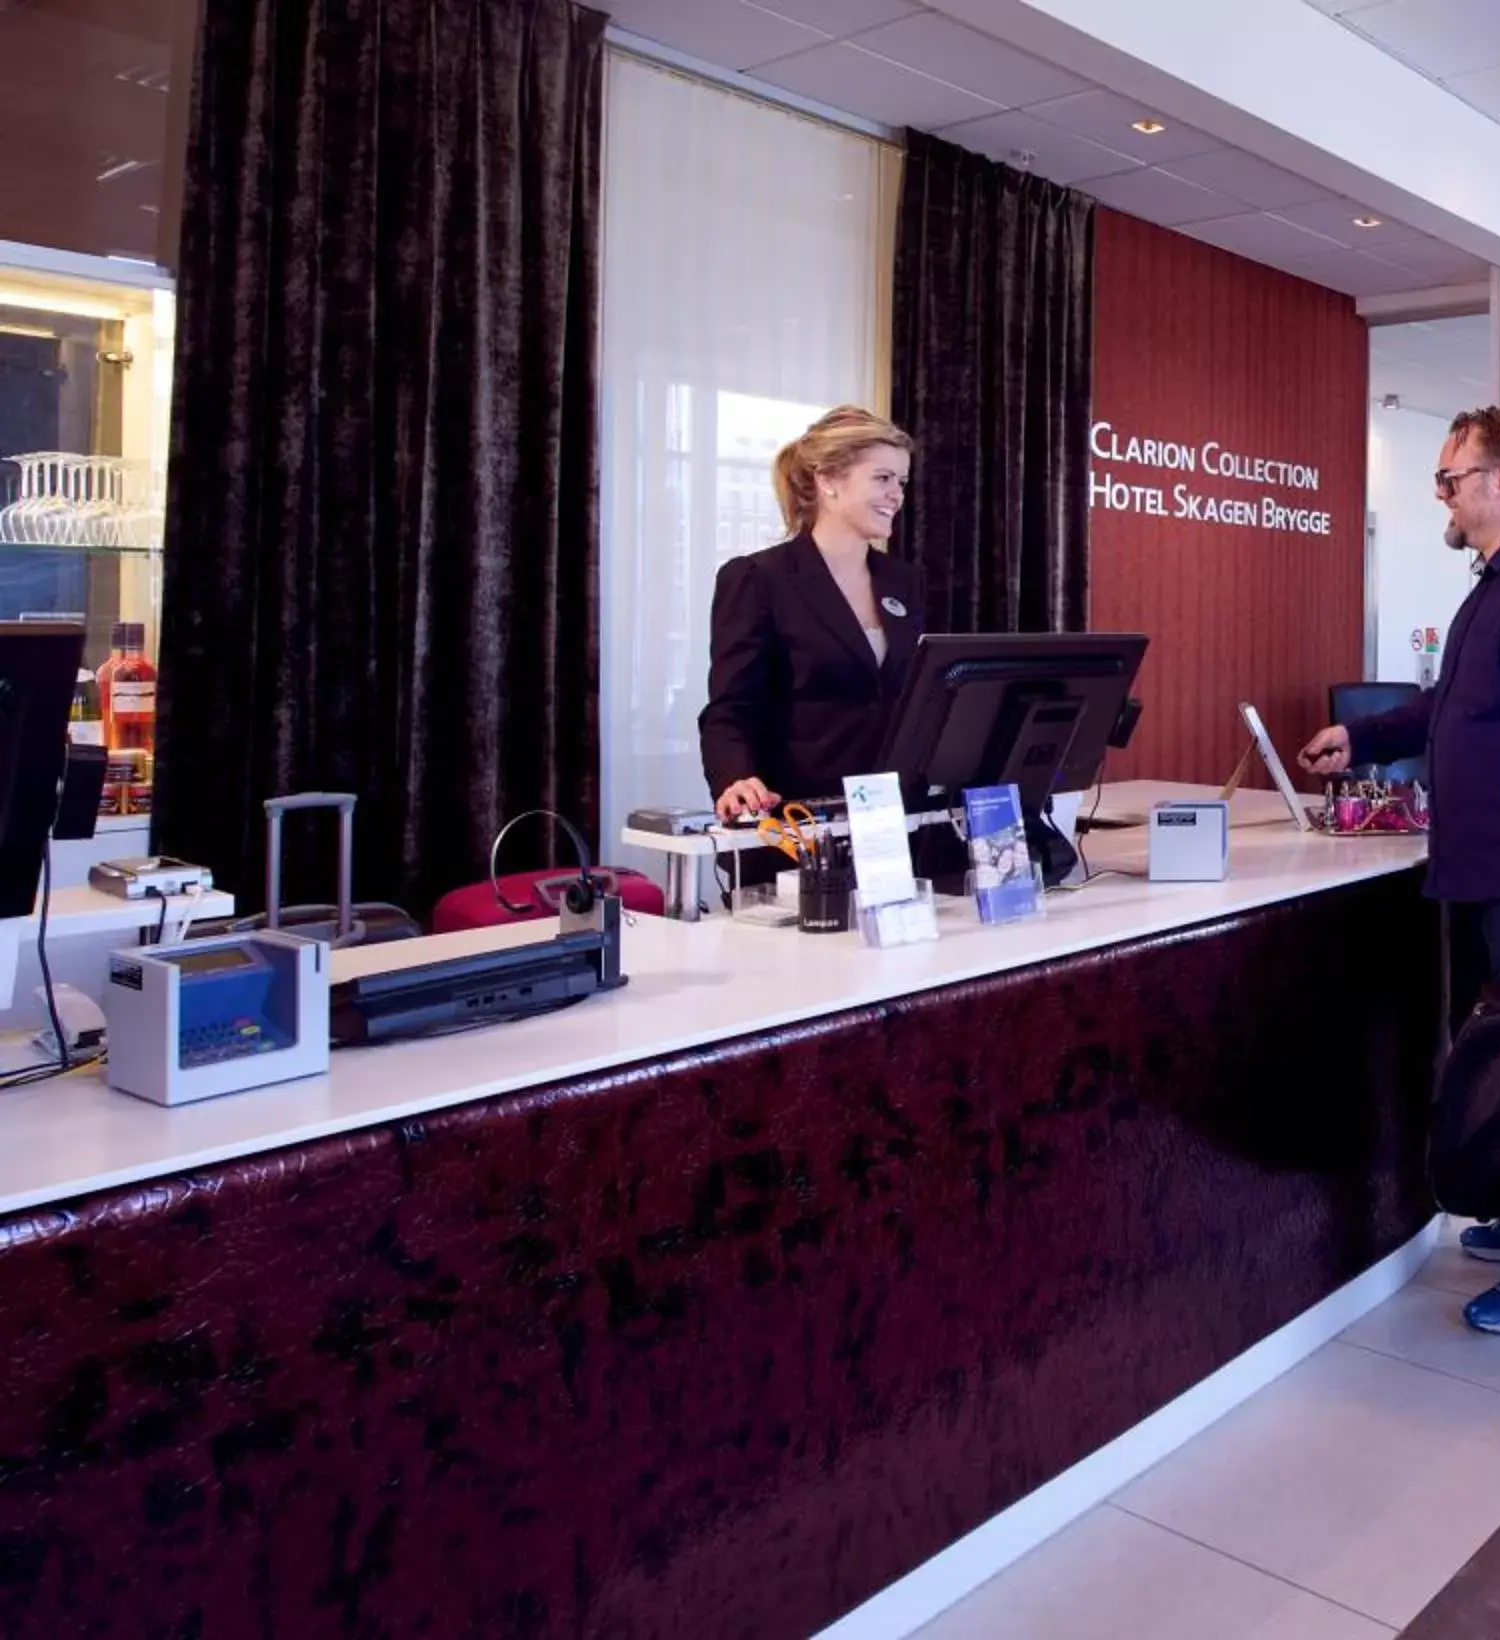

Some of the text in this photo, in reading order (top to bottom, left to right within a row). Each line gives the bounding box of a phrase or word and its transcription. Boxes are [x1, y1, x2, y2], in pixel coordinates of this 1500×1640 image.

[1091, 421, 1319, 490] CLARION COLLECTION
[1089, 472, 1331, 535] HOTEL SKAGEN BRYGGE
